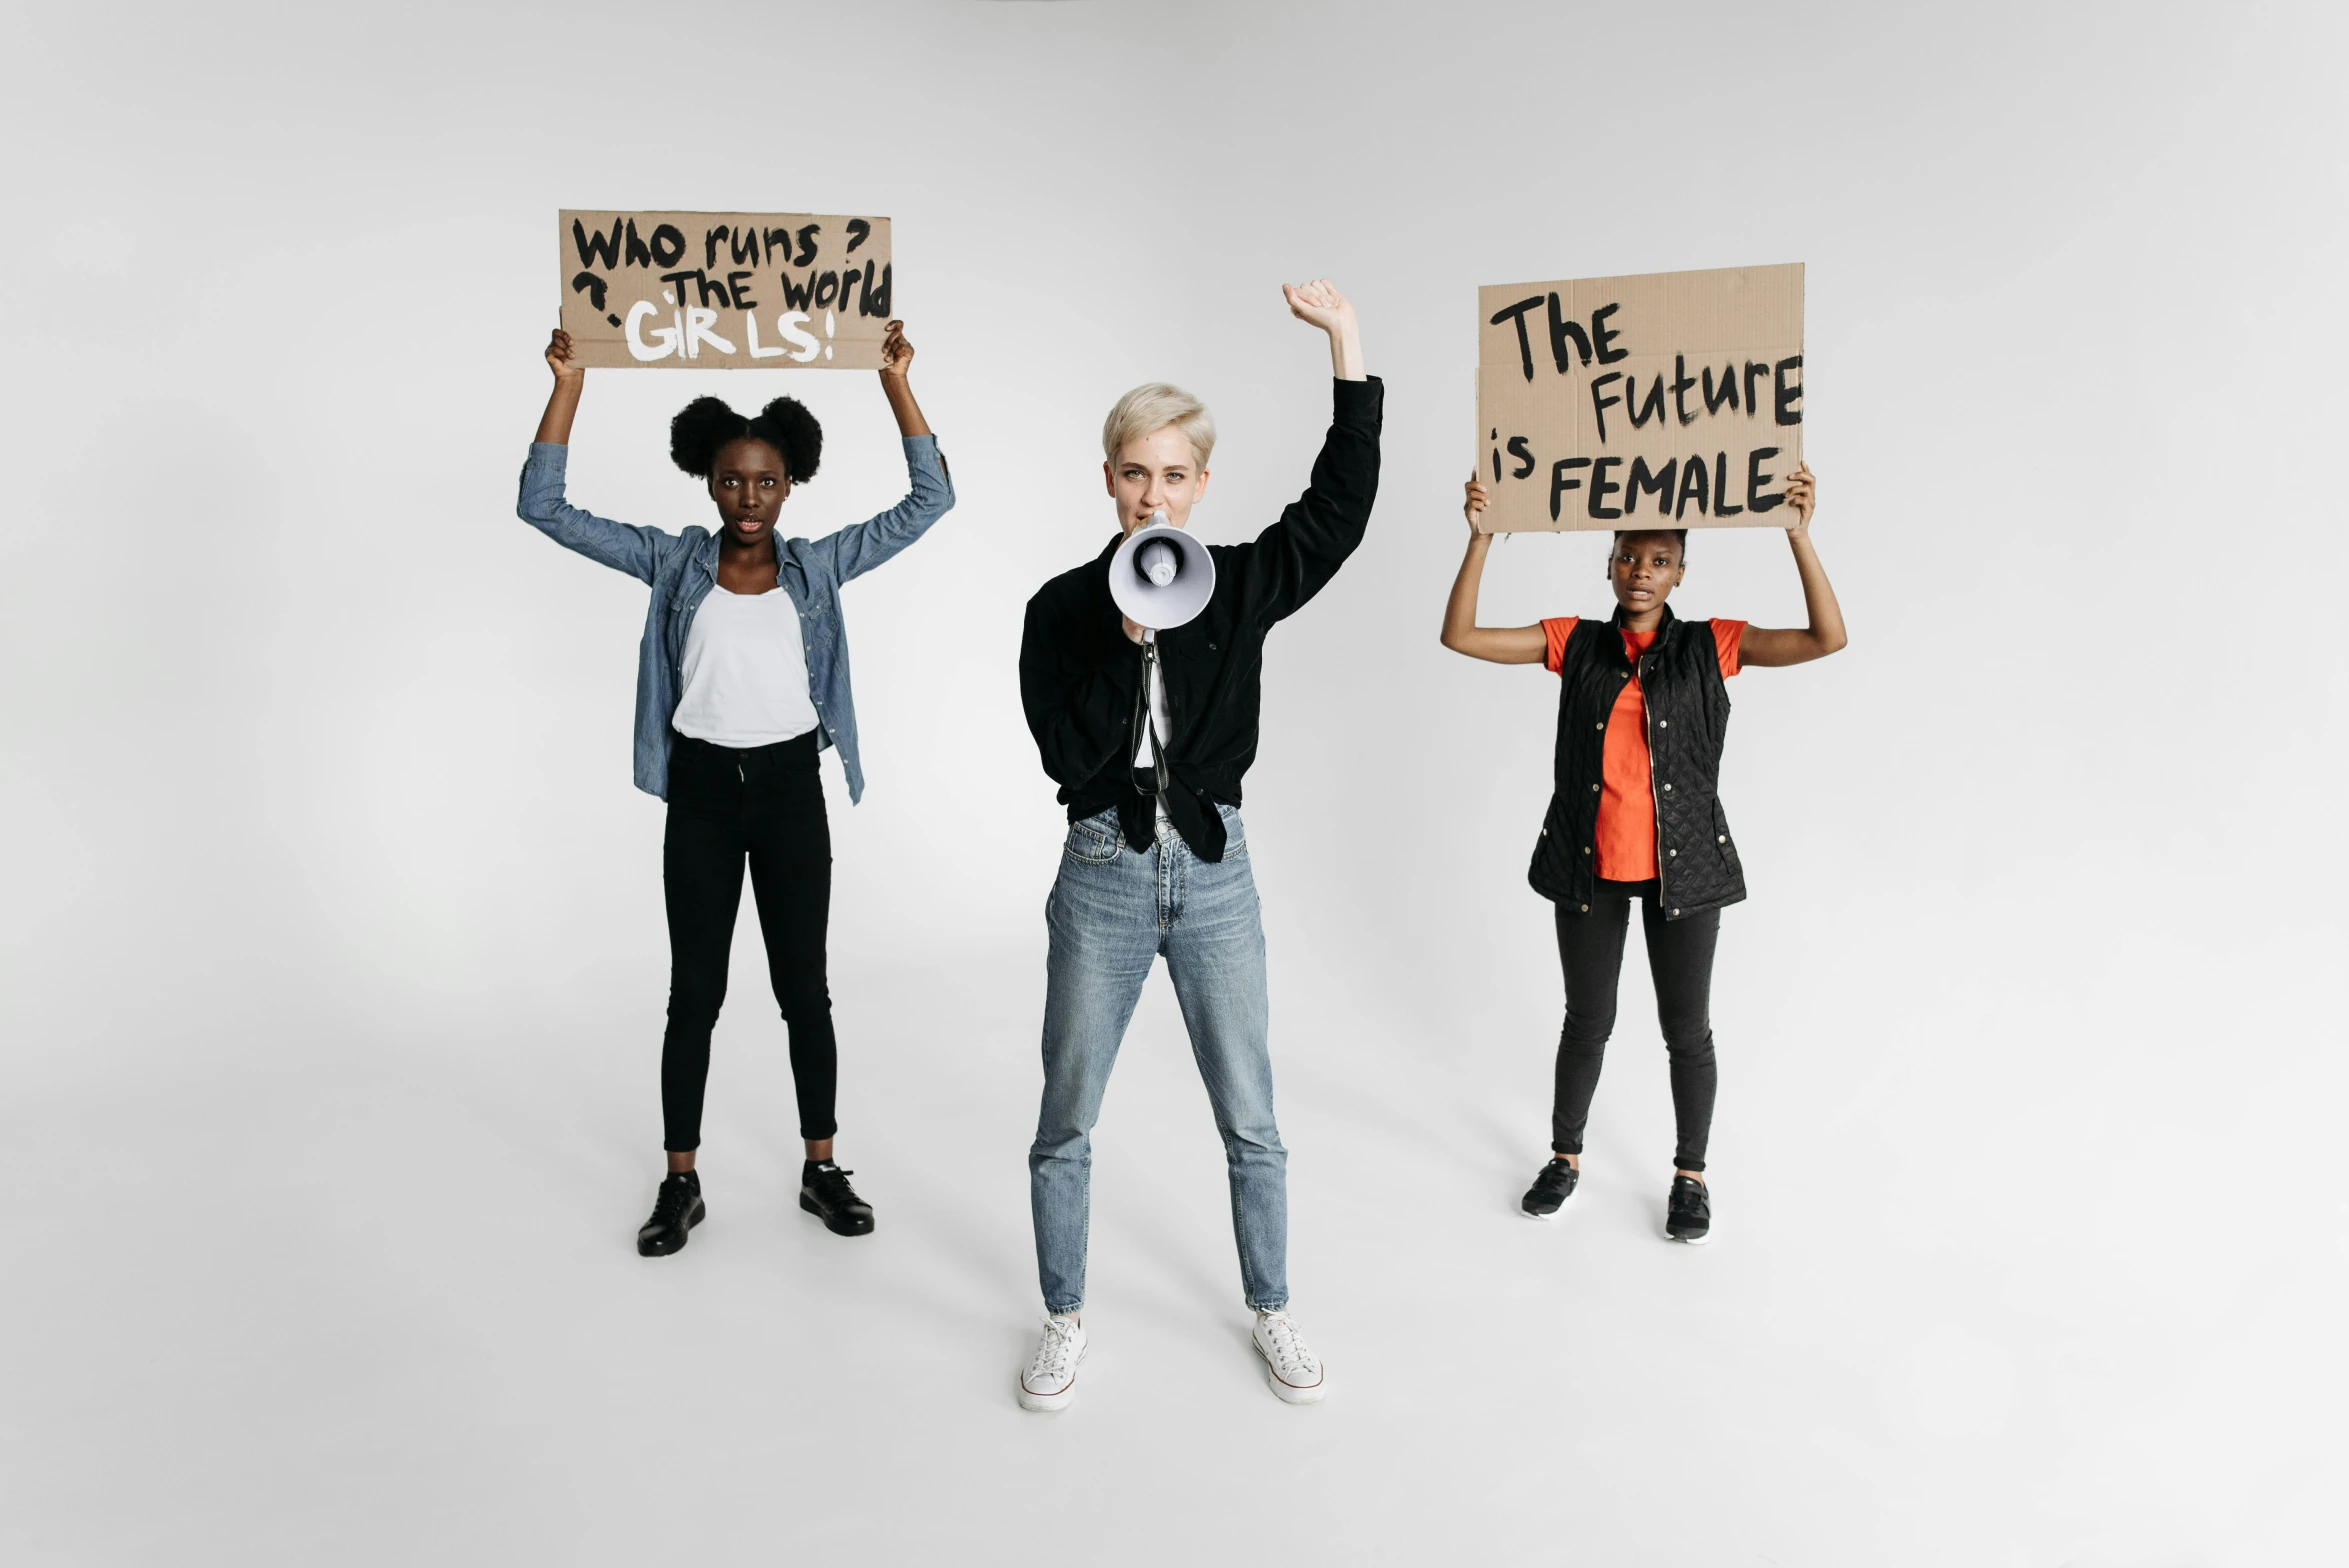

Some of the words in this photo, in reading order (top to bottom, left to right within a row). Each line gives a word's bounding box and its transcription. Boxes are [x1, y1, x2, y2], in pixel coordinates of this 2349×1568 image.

[704, 223, 821, 271] runs
[1490, 427, 1536, 484] is
[1549, 446, 1788, 522] FEMALE
